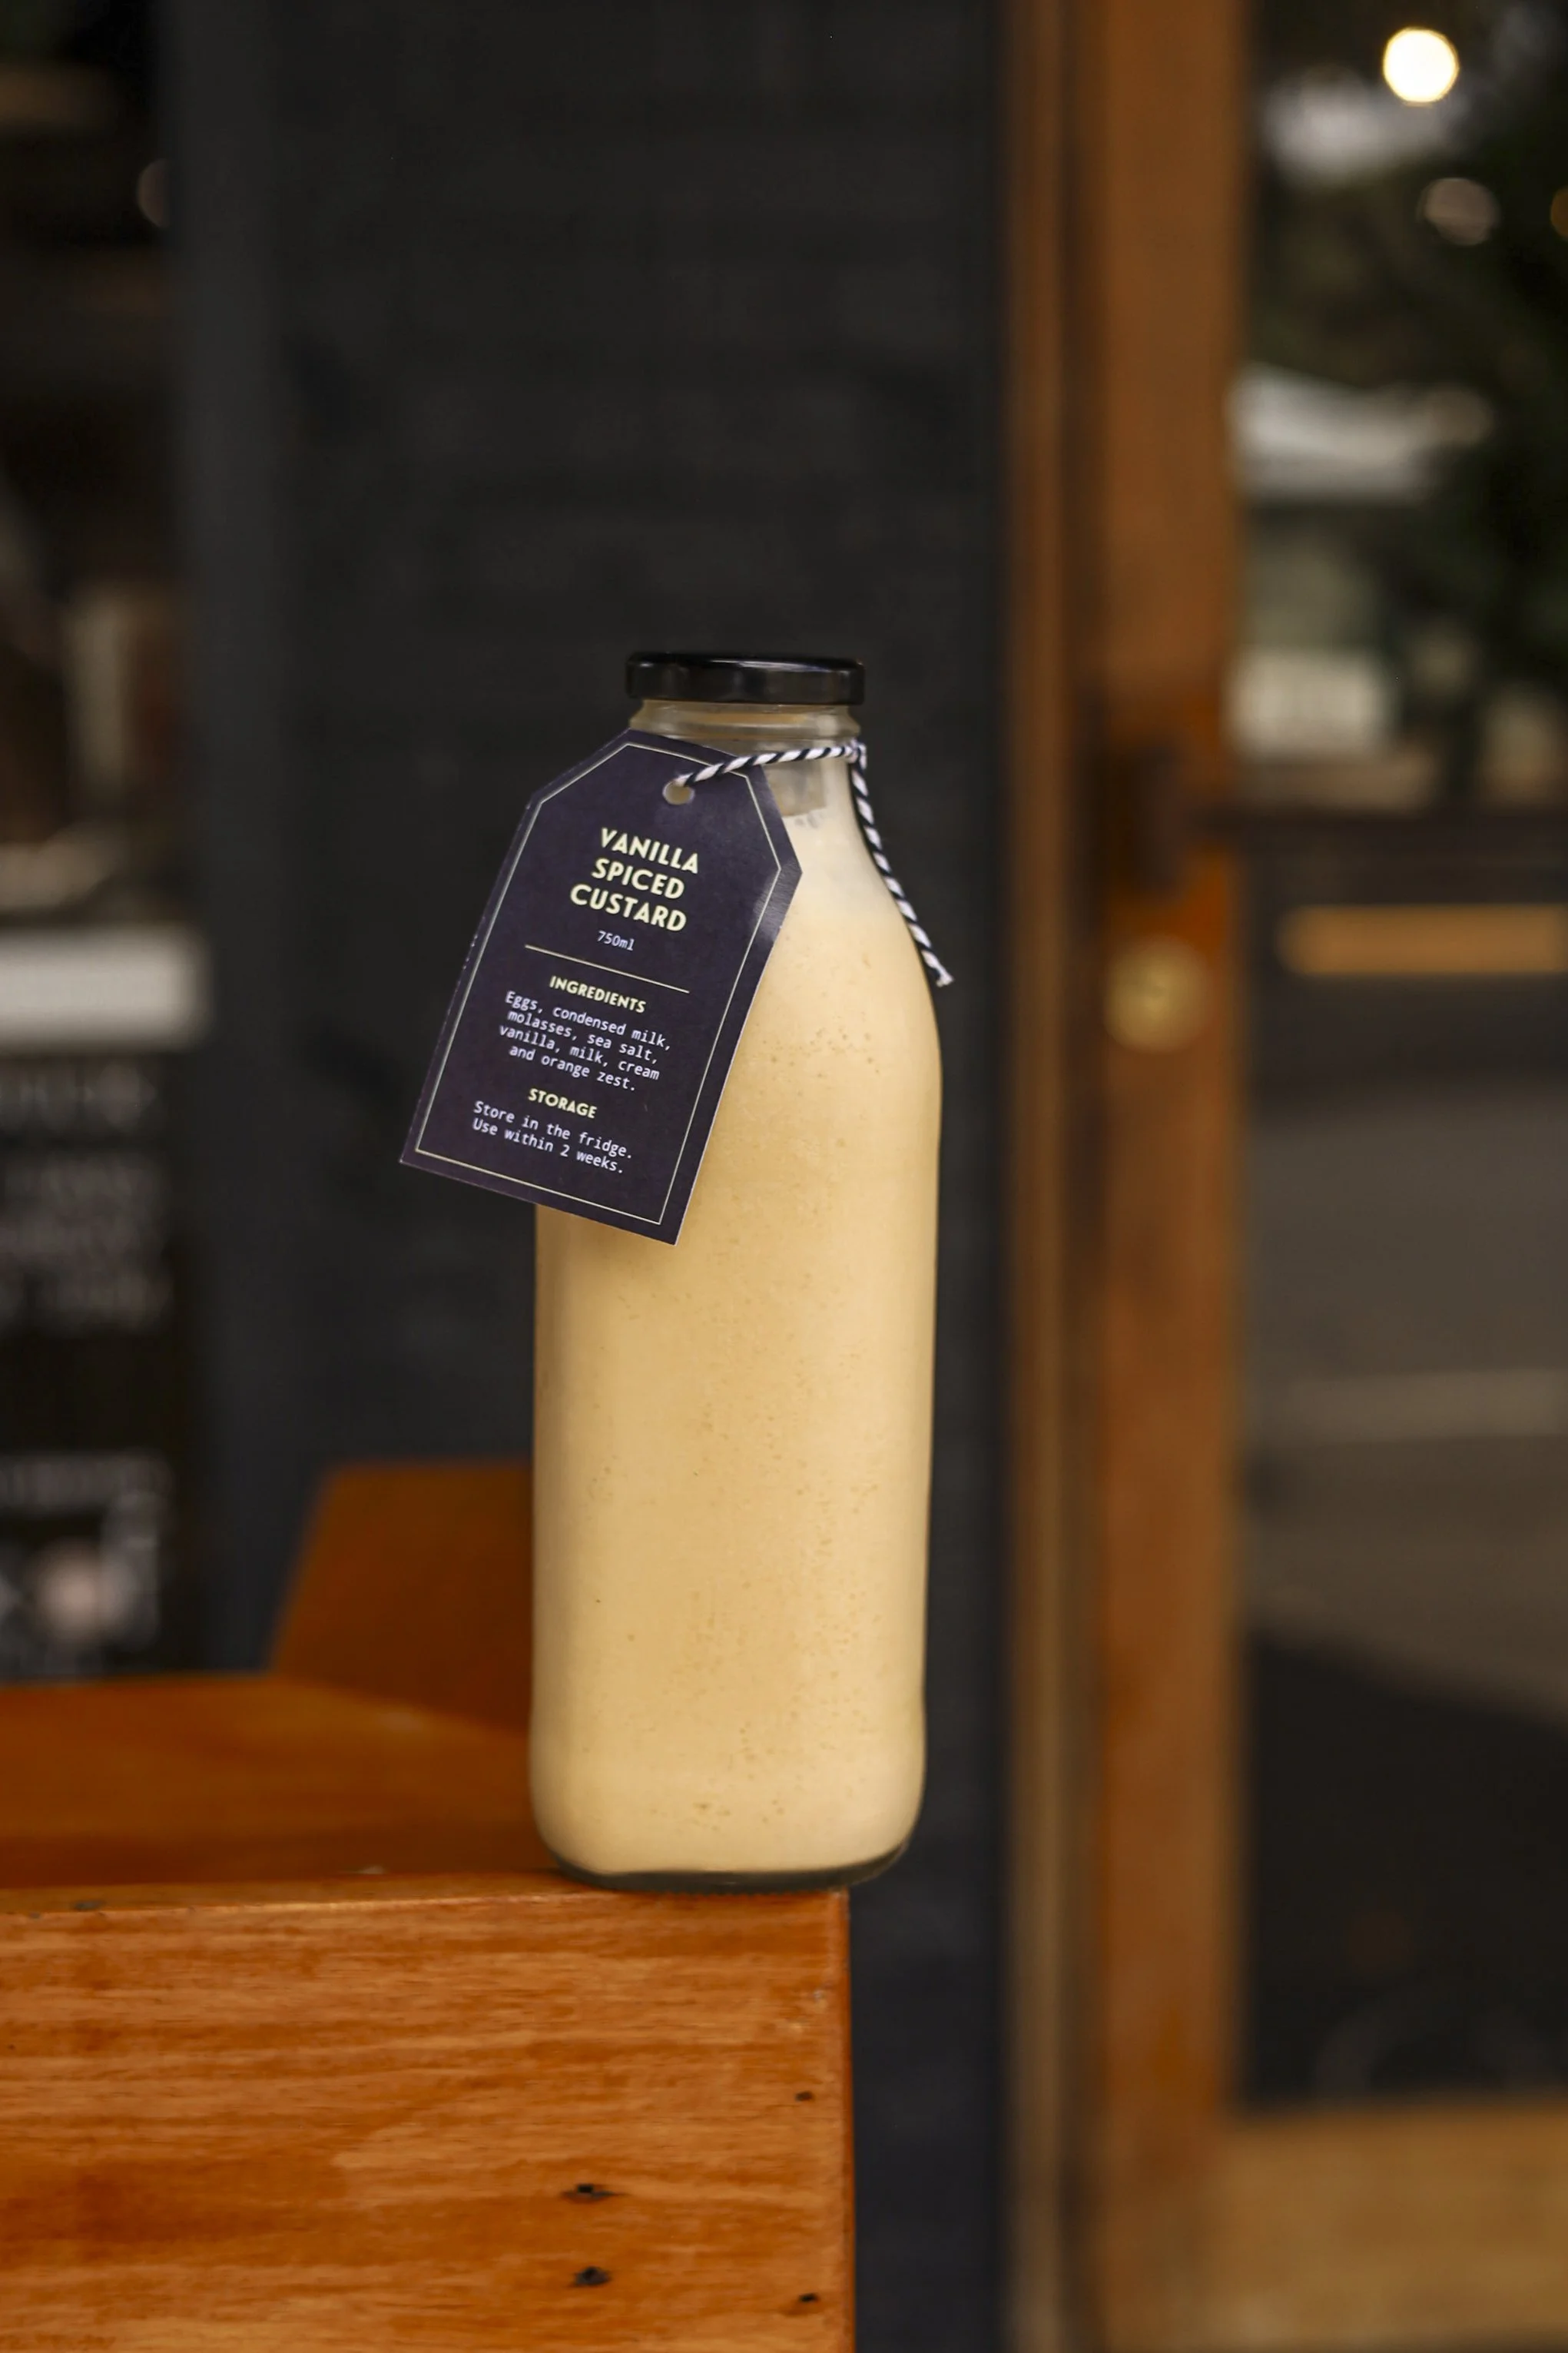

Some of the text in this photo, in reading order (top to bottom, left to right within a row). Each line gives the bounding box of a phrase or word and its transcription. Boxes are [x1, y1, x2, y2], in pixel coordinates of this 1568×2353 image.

[602, 828, 698, 874] VANILLA
[591, 858, 685, 899] SPICED
[570, 884, 687, 931] CUSTARD
[597, 931, 634, 951] 750ml
[549, 975, 647, 1013] INGREDIENTS
[506, 991, 671, 1050] Eggs, condensed milk,
[507, 1010, 658, 1064] molasses, sea salt,
[499, 1025, 659, 1080] vanilla, milk, cream
[509, 1045, 635, 1090] and orange zest.
[528, 1088, 598, 1119] STORAGE
[472, 1118, 623, 1173] Use within 2 weeks.
[473, 1101, 632, 1159] Store in the fridge.
